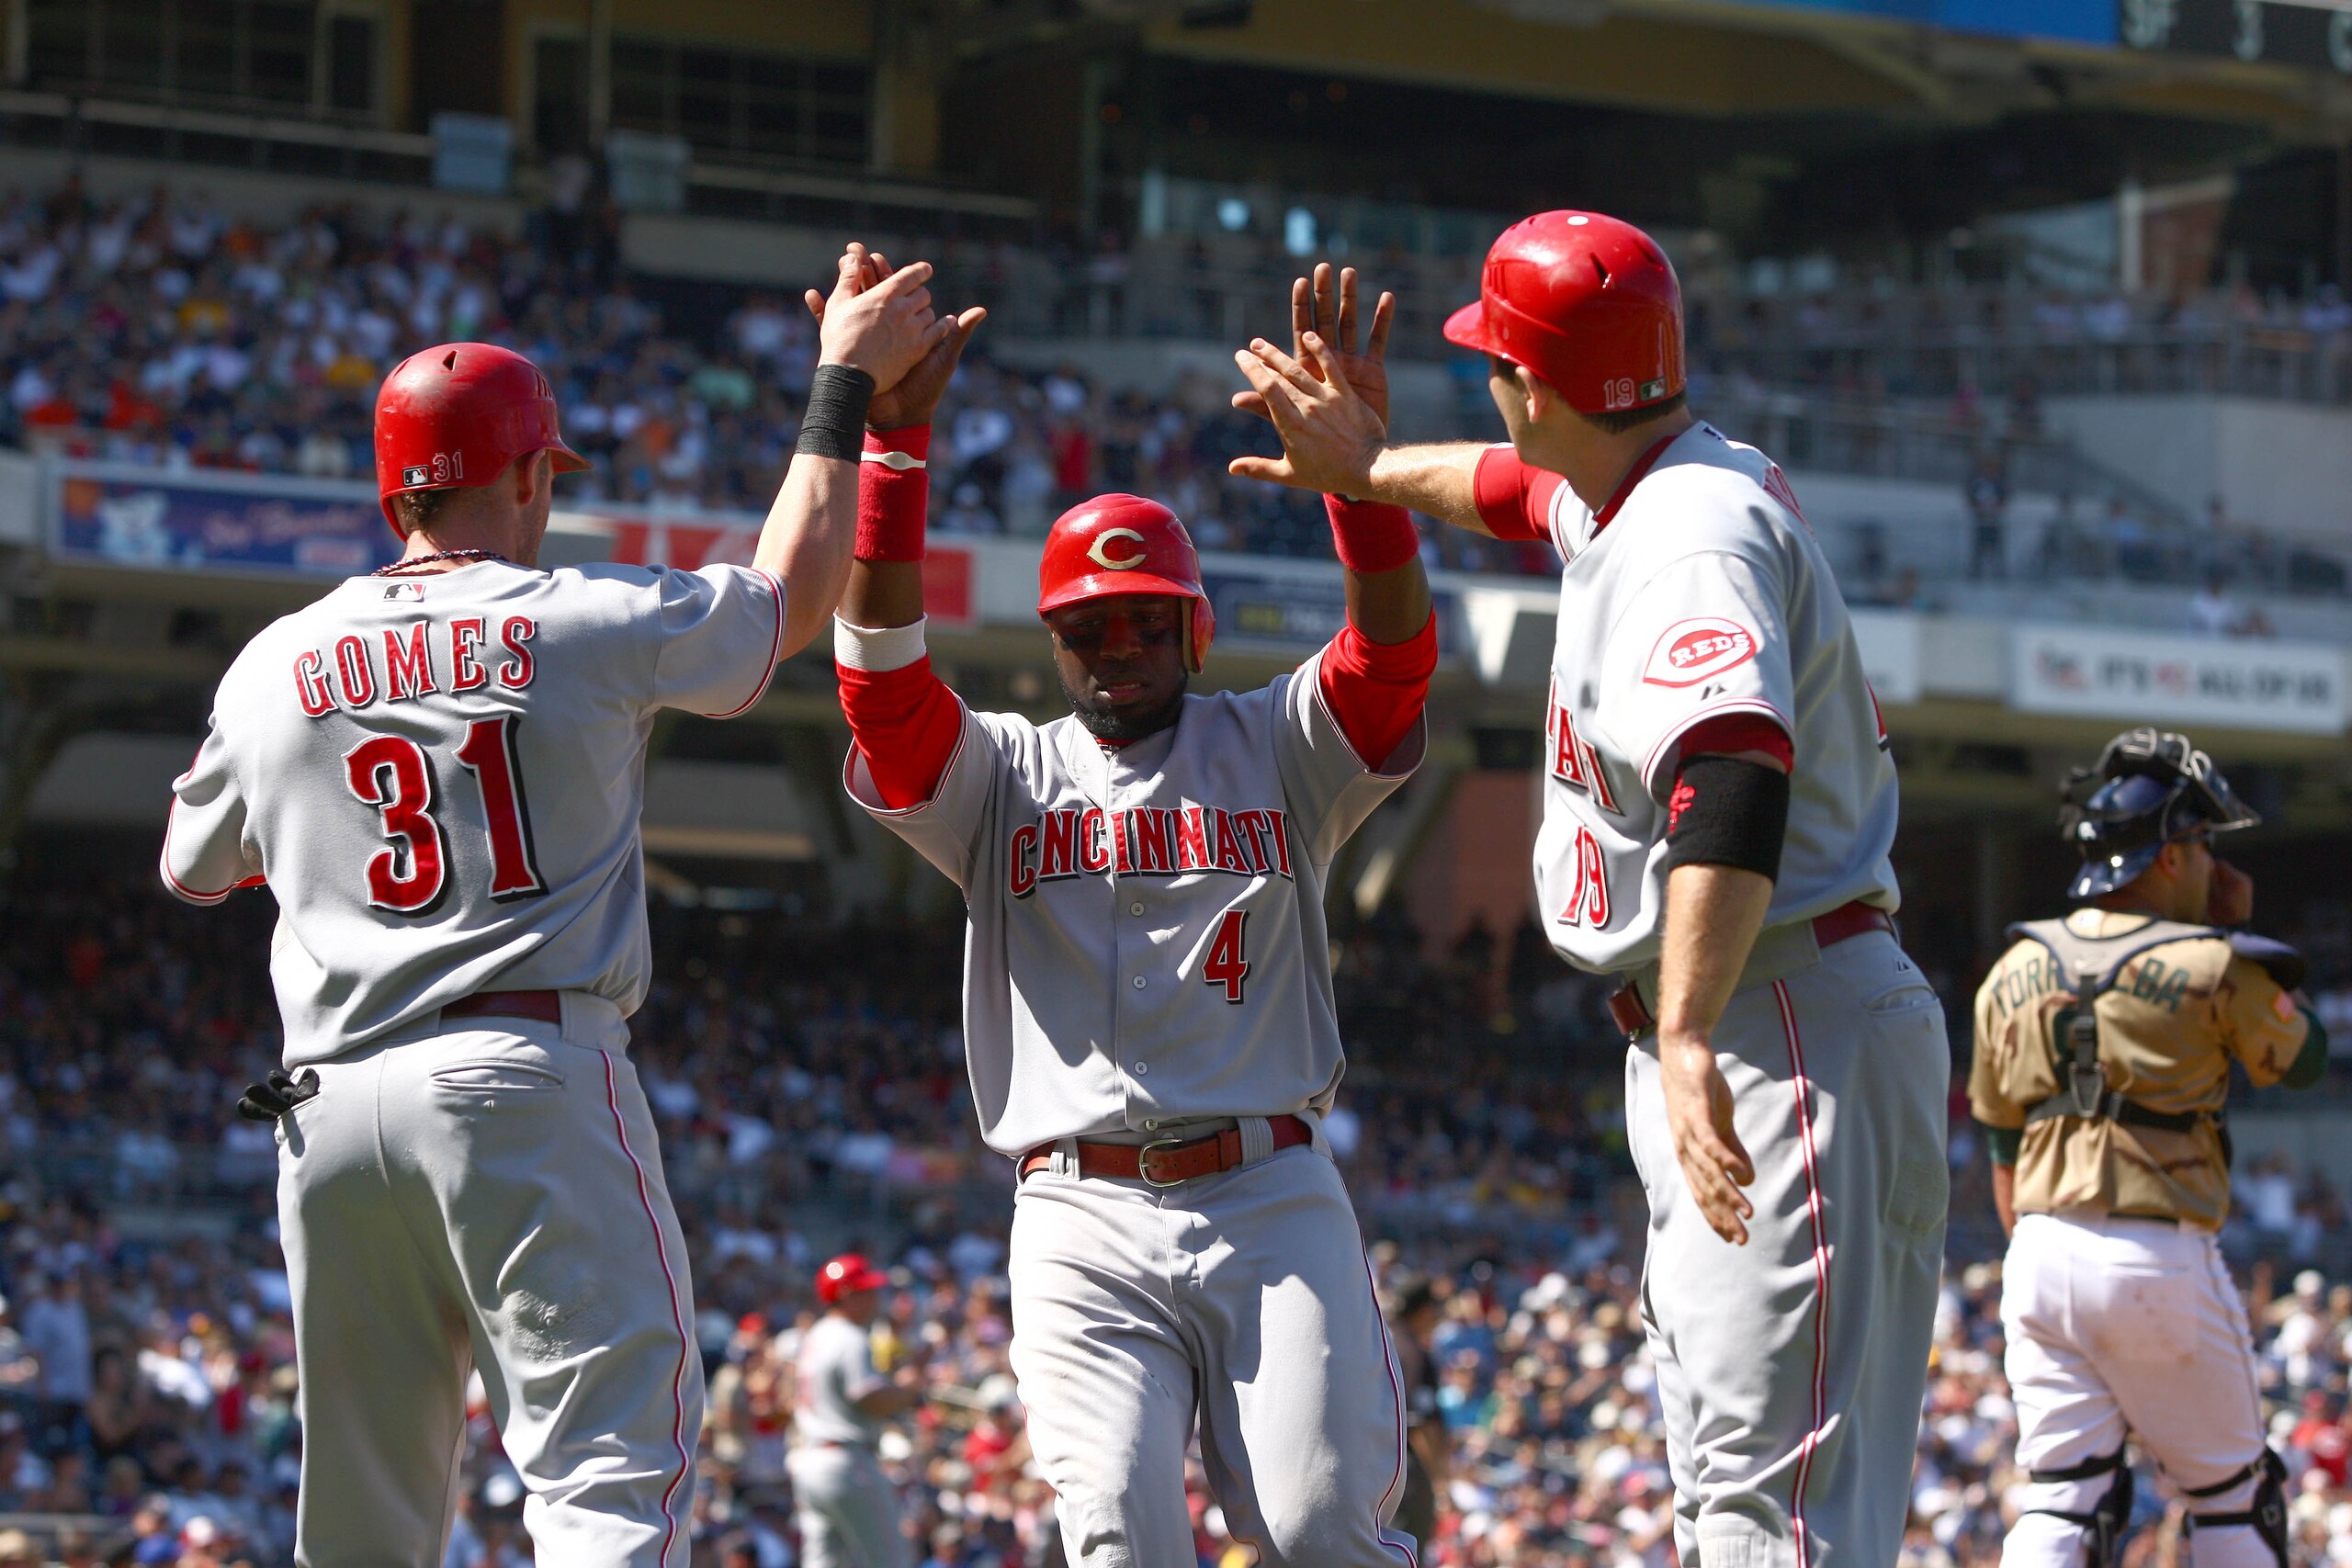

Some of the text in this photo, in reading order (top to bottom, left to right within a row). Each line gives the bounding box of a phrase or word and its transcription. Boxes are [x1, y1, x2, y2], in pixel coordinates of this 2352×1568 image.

[1603, 377, 1635, 409] 19
[432, 451, 463, 482] 31
[1086, 527, 1147, 570] C
[293, 615, 536, 718] GOMES
[1670, 633, 1750, 669] REDS
[340, 713, 549, 919] 31
[1556, 823, 1610, 931] 19
[1202, 908, 1250, 1004] 4
